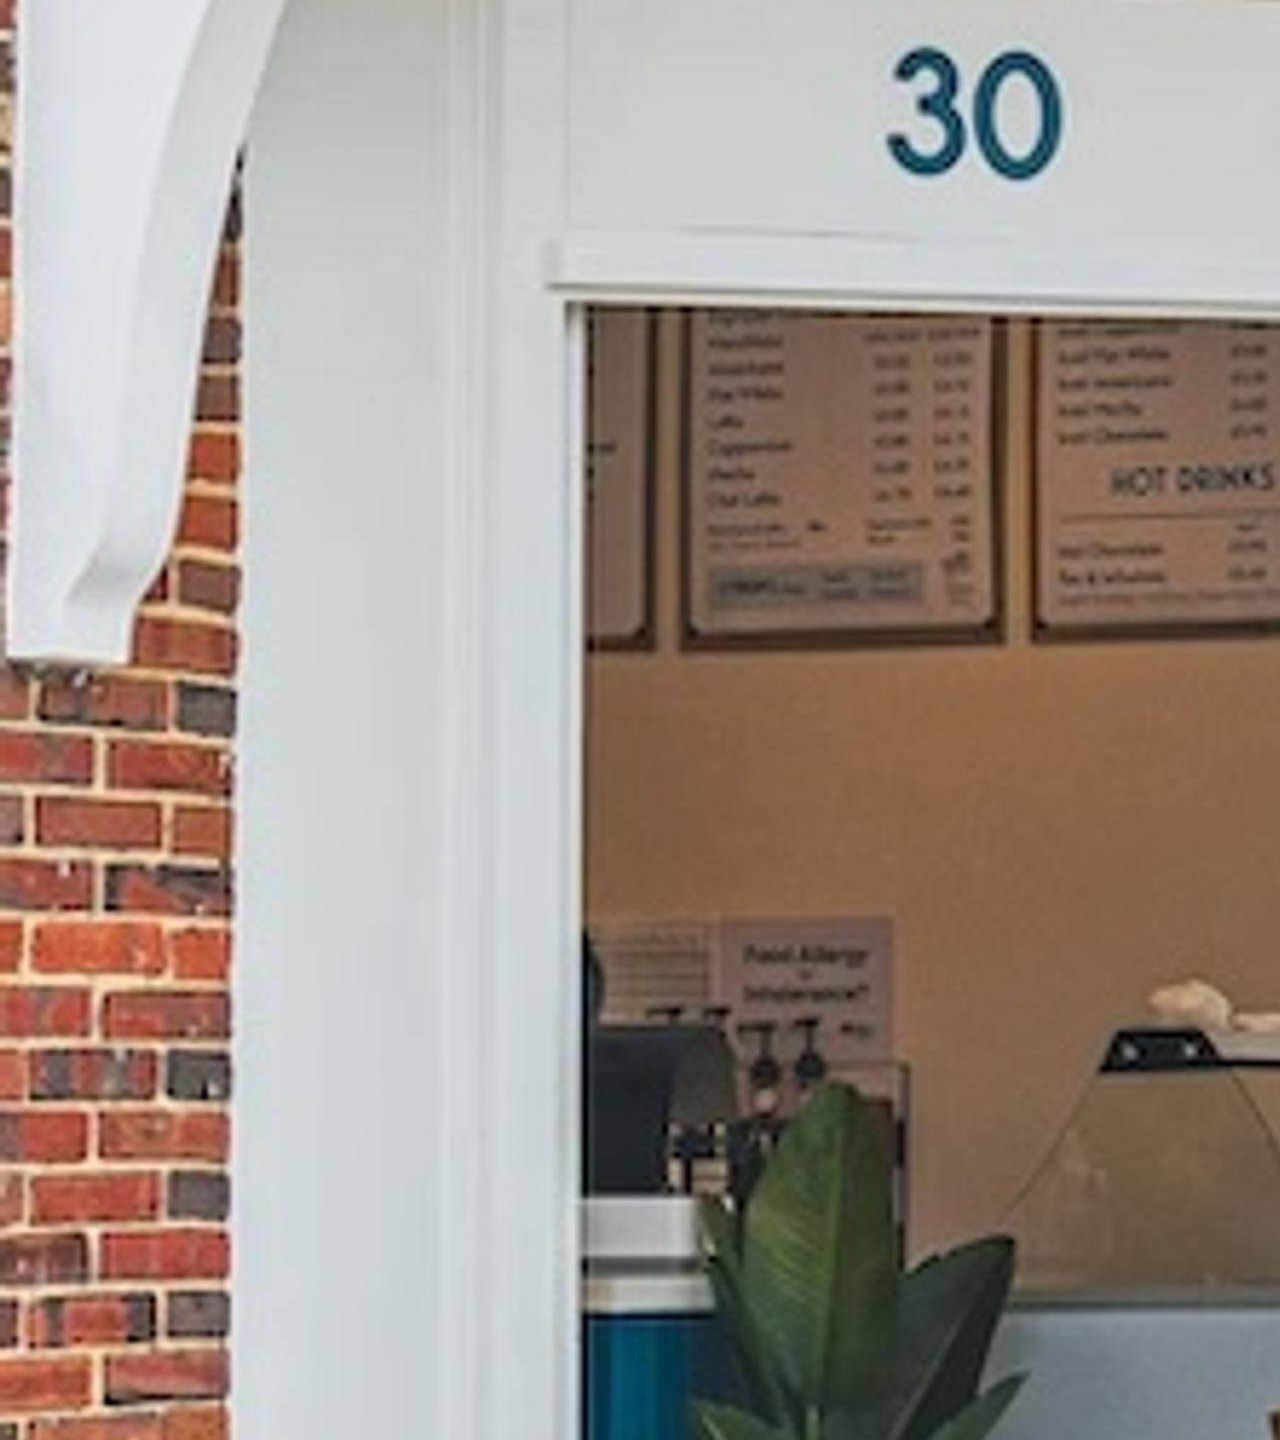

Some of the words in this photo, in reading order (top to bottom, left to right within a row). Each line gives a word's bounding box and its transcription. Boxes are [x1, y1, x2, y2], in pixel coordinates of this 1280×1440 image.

[886, 46, 1062, 181] 30
[1110, 466, 1167, 496] HOT
[1176, 462, 1276, 494] DRINKS
